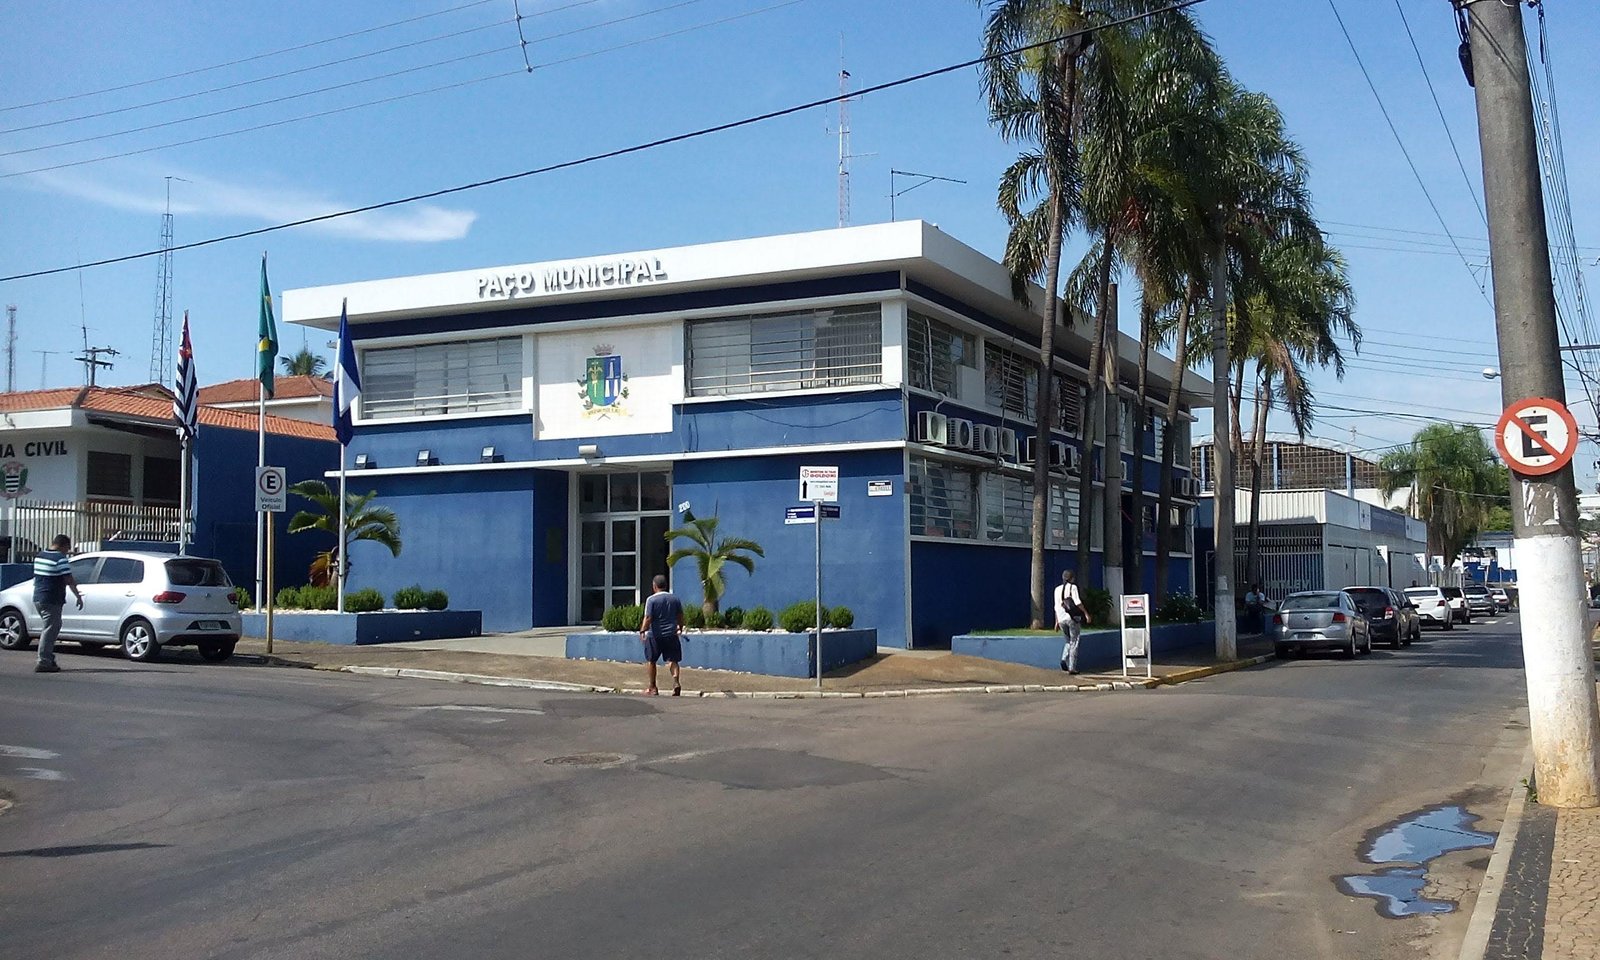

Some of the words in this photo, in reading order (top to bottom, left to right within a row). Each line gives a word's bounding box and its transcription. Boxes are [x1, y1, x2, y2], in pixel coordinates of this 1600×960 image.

[478, 271, 536, 299] PAÇO
[544, 257, 668, 292] MUNICIPAL
[25, 441, 67, 457] CIVIL
[1520, 415, 1552, 457] E
[267, 475, 276, 489] E
